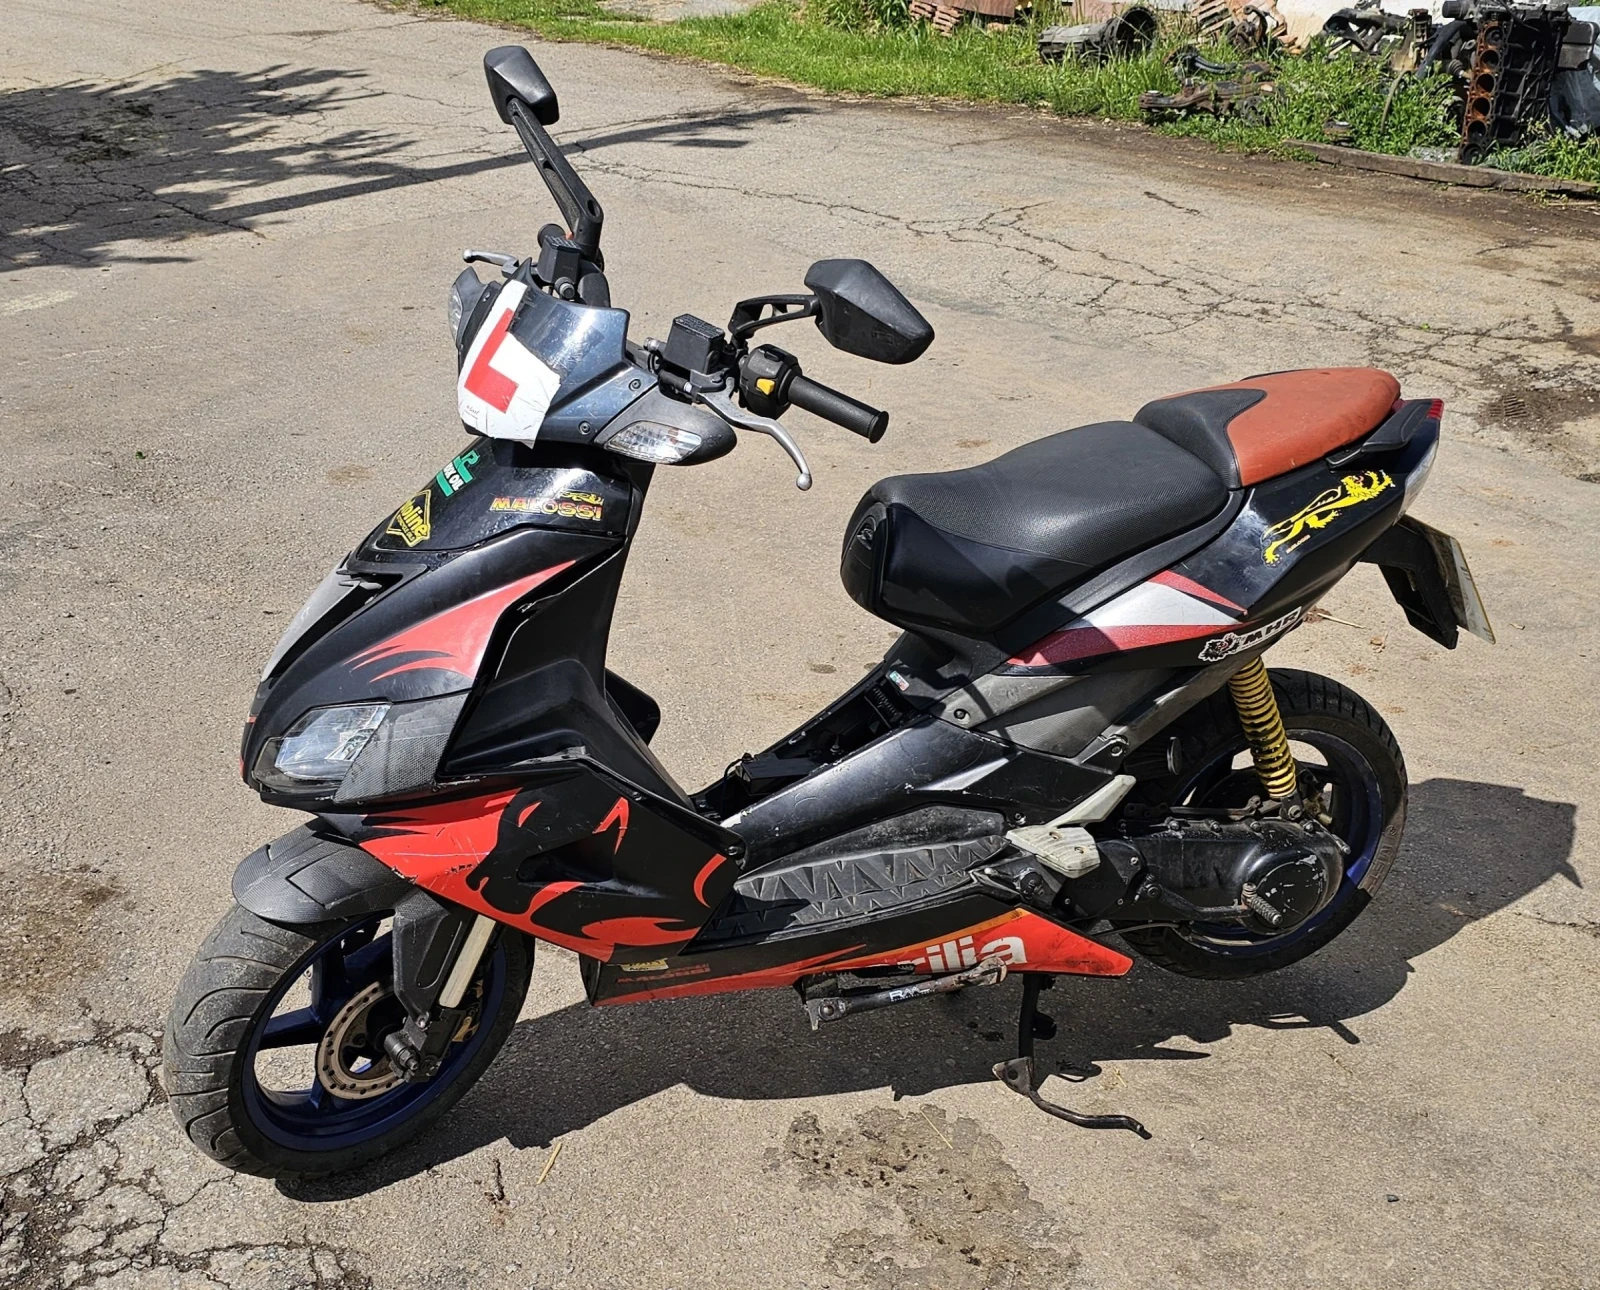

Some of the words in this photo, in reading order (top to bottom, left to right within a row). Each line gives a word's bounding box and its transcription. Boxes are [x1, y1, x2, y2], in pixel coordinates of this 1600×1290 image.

[464, 308, 519, 414] L
[448, 472, 465, 492] OIL
[489, 496, 603, 521] MALOSSI
[1243, 610, 1300, 645] MHR
